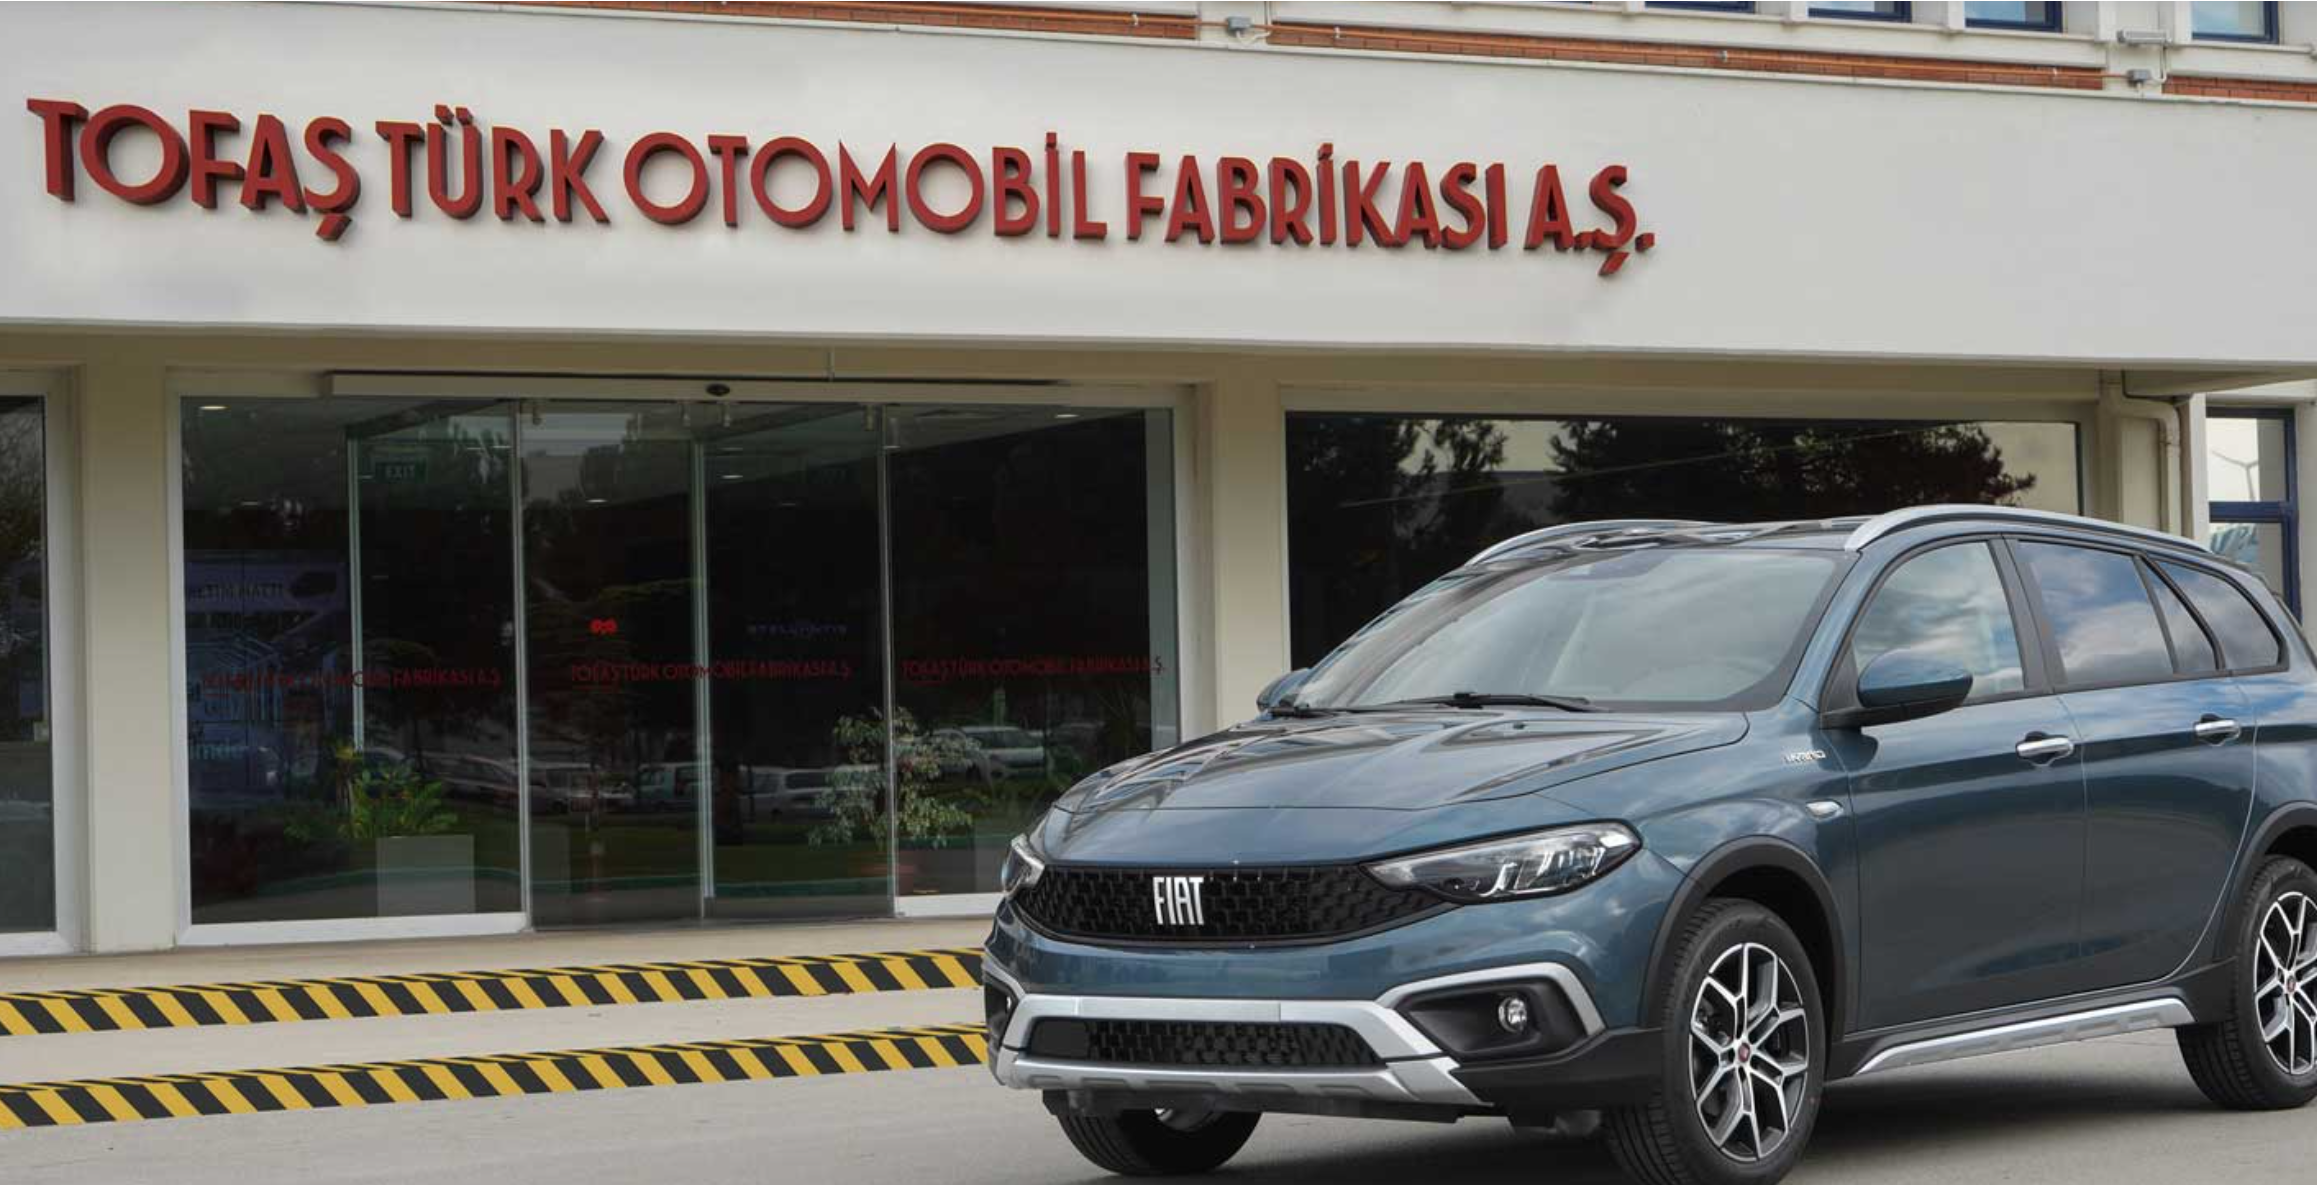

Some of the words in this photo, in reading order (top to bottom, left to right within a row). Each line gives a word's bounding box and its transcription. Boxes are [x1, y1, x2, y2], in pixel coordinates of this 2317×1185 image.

[26, 97, 361, 240] TOFAŞ
[375, 102, 611, 224] TÜRK
[623, 131, 1107, 239] OTOMOBİL
[1124, 142, 1509, 249] FABRİKASI
[1523, 162, 1657, 275] A.Ş.
[1153, 876, 1204, 926] FIAT
